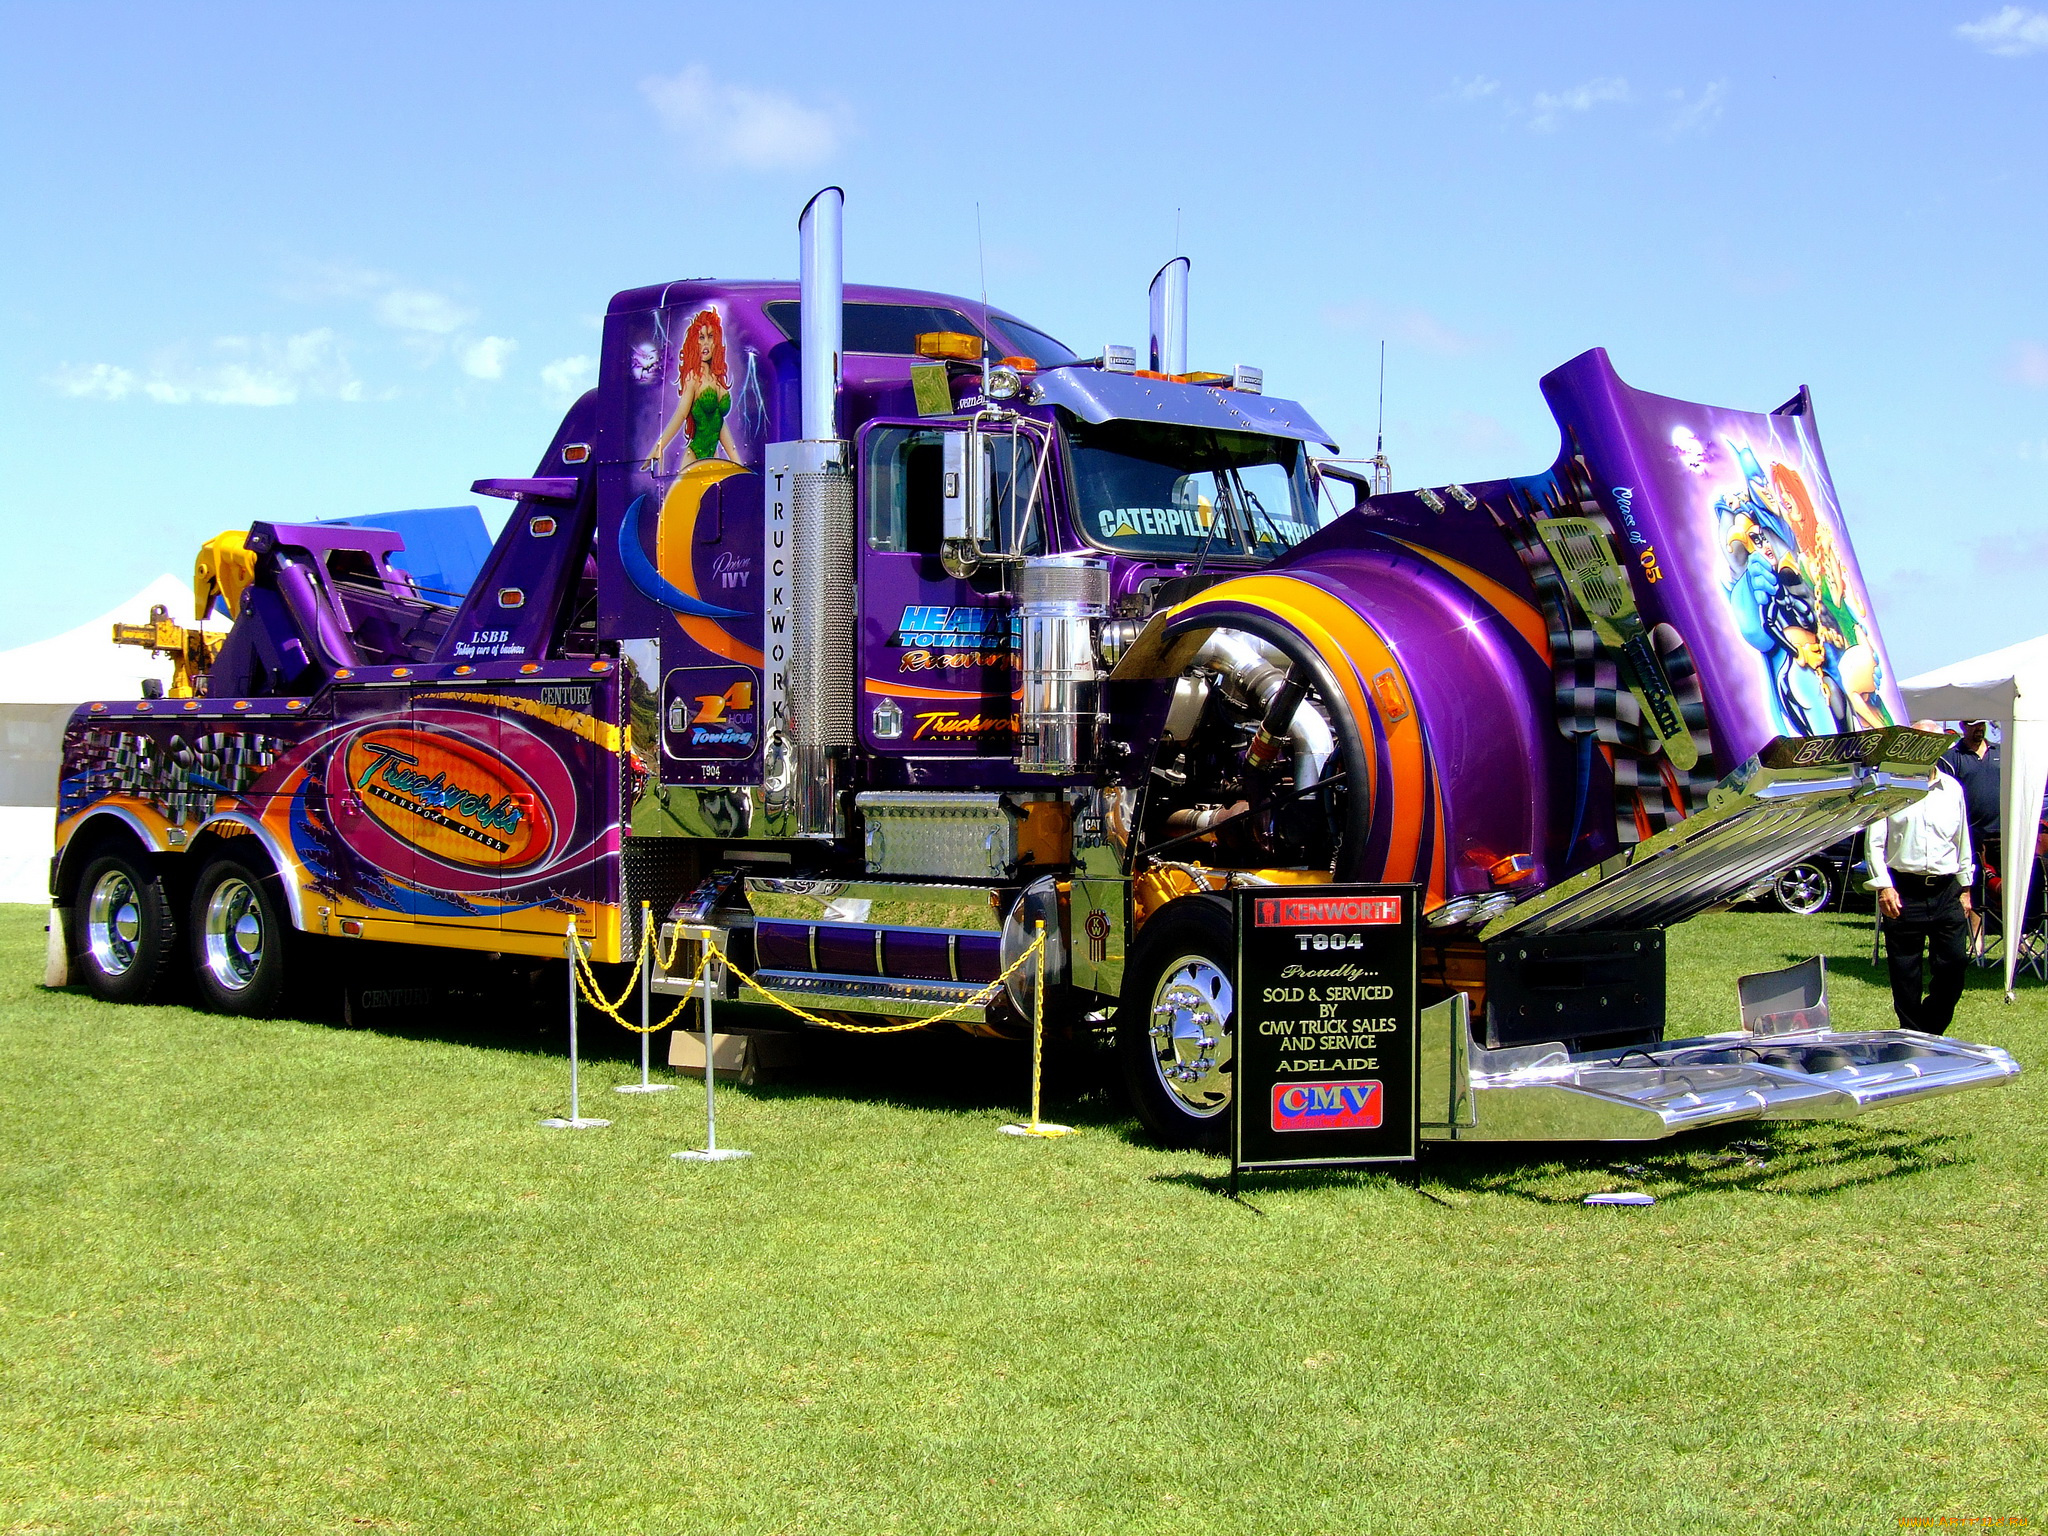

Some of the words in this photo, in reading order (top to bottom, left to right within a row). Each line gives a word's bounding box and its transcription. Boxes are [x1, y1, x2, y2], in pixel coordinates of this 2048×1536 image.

[1611, 486, 1636, 527] Class
[1629, 530, 1647, 545] of
[1640, 545, 1664, 584] '05
[722, 570, 750, 589] IVY
[771, 473, 786, 747] TRUCKWORKS
[471, 630, 509, 644] LSBB
[899, 633, 999, 649] TOWING
[453, 641, 476, 659] Taking
[492, 643, 500, 657] of
[540, 686, 592, 706] CENTURY
[691, 681, 754, 724] 24
[728, 713, 753, 725] HOUR
[912, 711, 1012, 742] Truckwo
[691, 727, 753, 746] Towing
[1792, 733, 1884, 764] BLING
[1885, 732, 1947, 762] BLING
[701, 765, 721, 777] T904
[357, 742, 522, 835] Truckworks
[374, 786, 450, 826] TRANSPORT
[458, 825, 503, 851] CRASH
[1084, 818, 1101, 831] CAT
[1285, 901, 1397, 921] KENWORTH
[1294, 933, 1364, 951] T904
[1280, 963, 1379, 982] Proudly...
[1262, 987, 1305, 1003] SOLD
[1308, 987, 1322, 1002] &
[1325, 985, 1394, 1001] SERVICED
[1319, 1003, 1339, 1018] BY
[1258, 1020, 1295, 1036] CMV
[1298, 1019, 1348, 1035] TRUCK
[1351, 1017, 1397, 1033] SALES
[1279, 1036, 1316, 1051] AND
[1319, 1034, 1377, 1050] SERVICE
[1275, 1057, 1380, 1073] ADELAIDE
[1280, 1084, 1377, 1116] CMV
